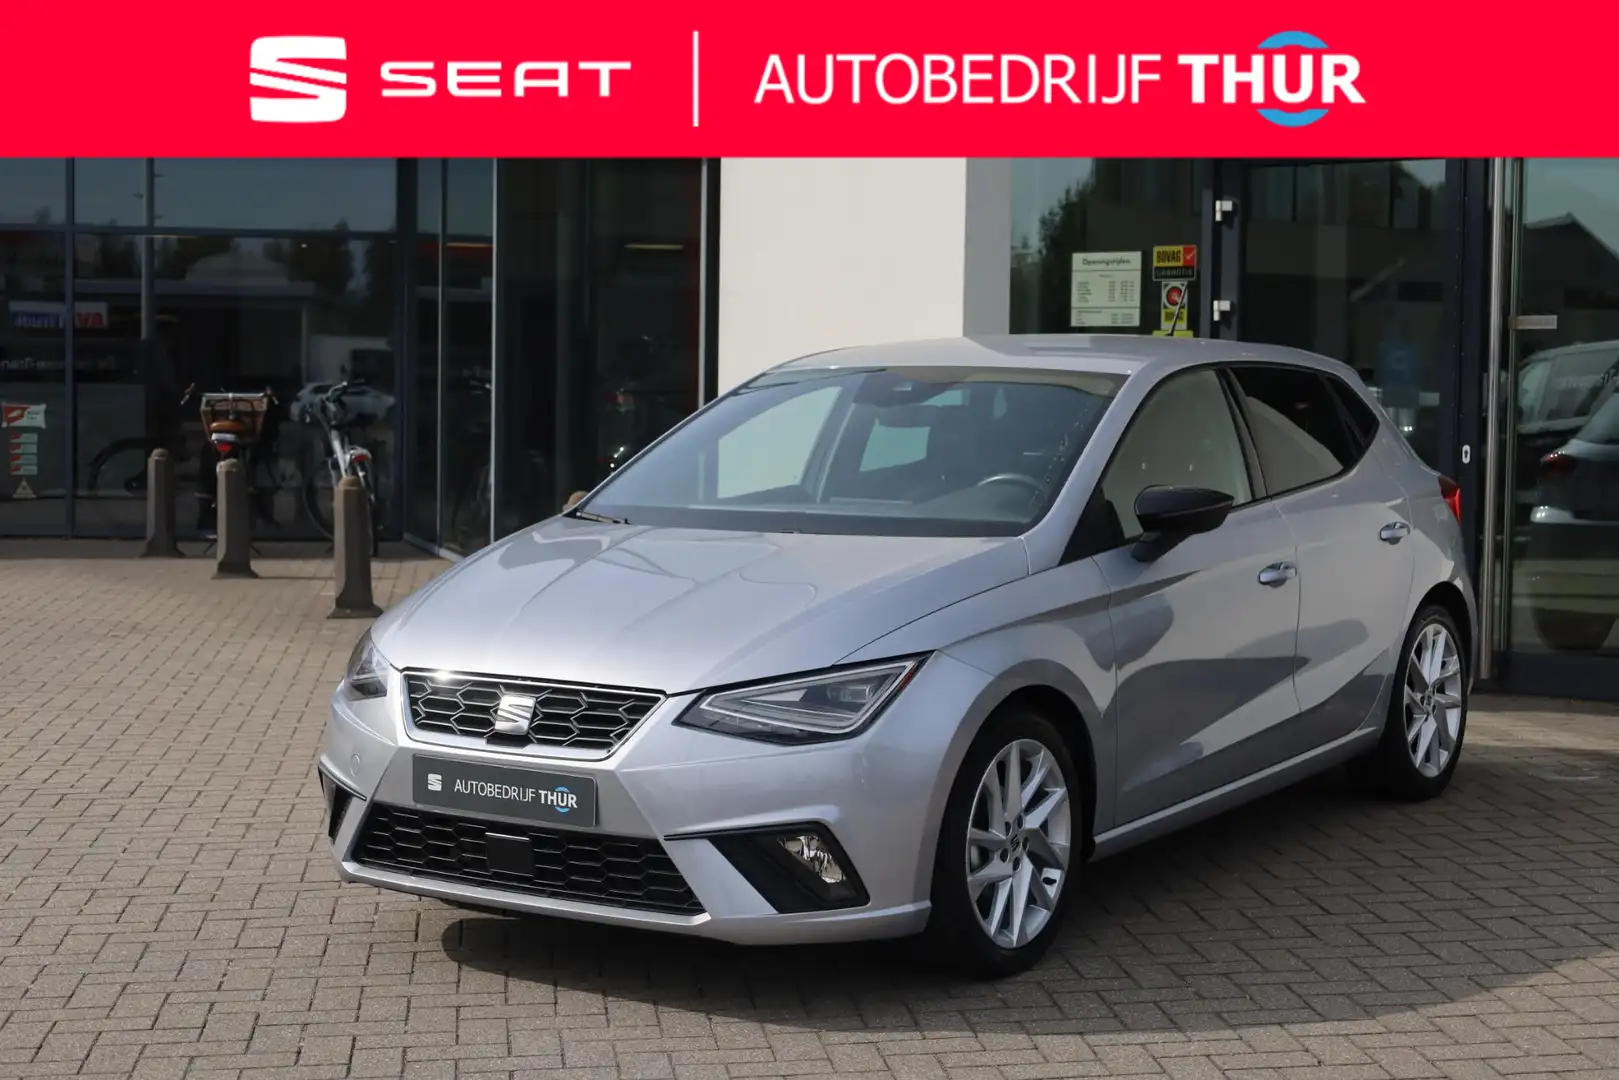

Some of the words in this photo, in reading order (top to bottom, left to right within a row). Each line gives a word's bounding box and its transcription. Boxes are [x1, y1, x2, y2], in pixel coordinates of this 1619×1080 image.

[1156, 249, 1181, 264] BOVAG
[454, 779, 536, 803] AUTOBEDRIJF
[539, 790, 578, 809] THUR
